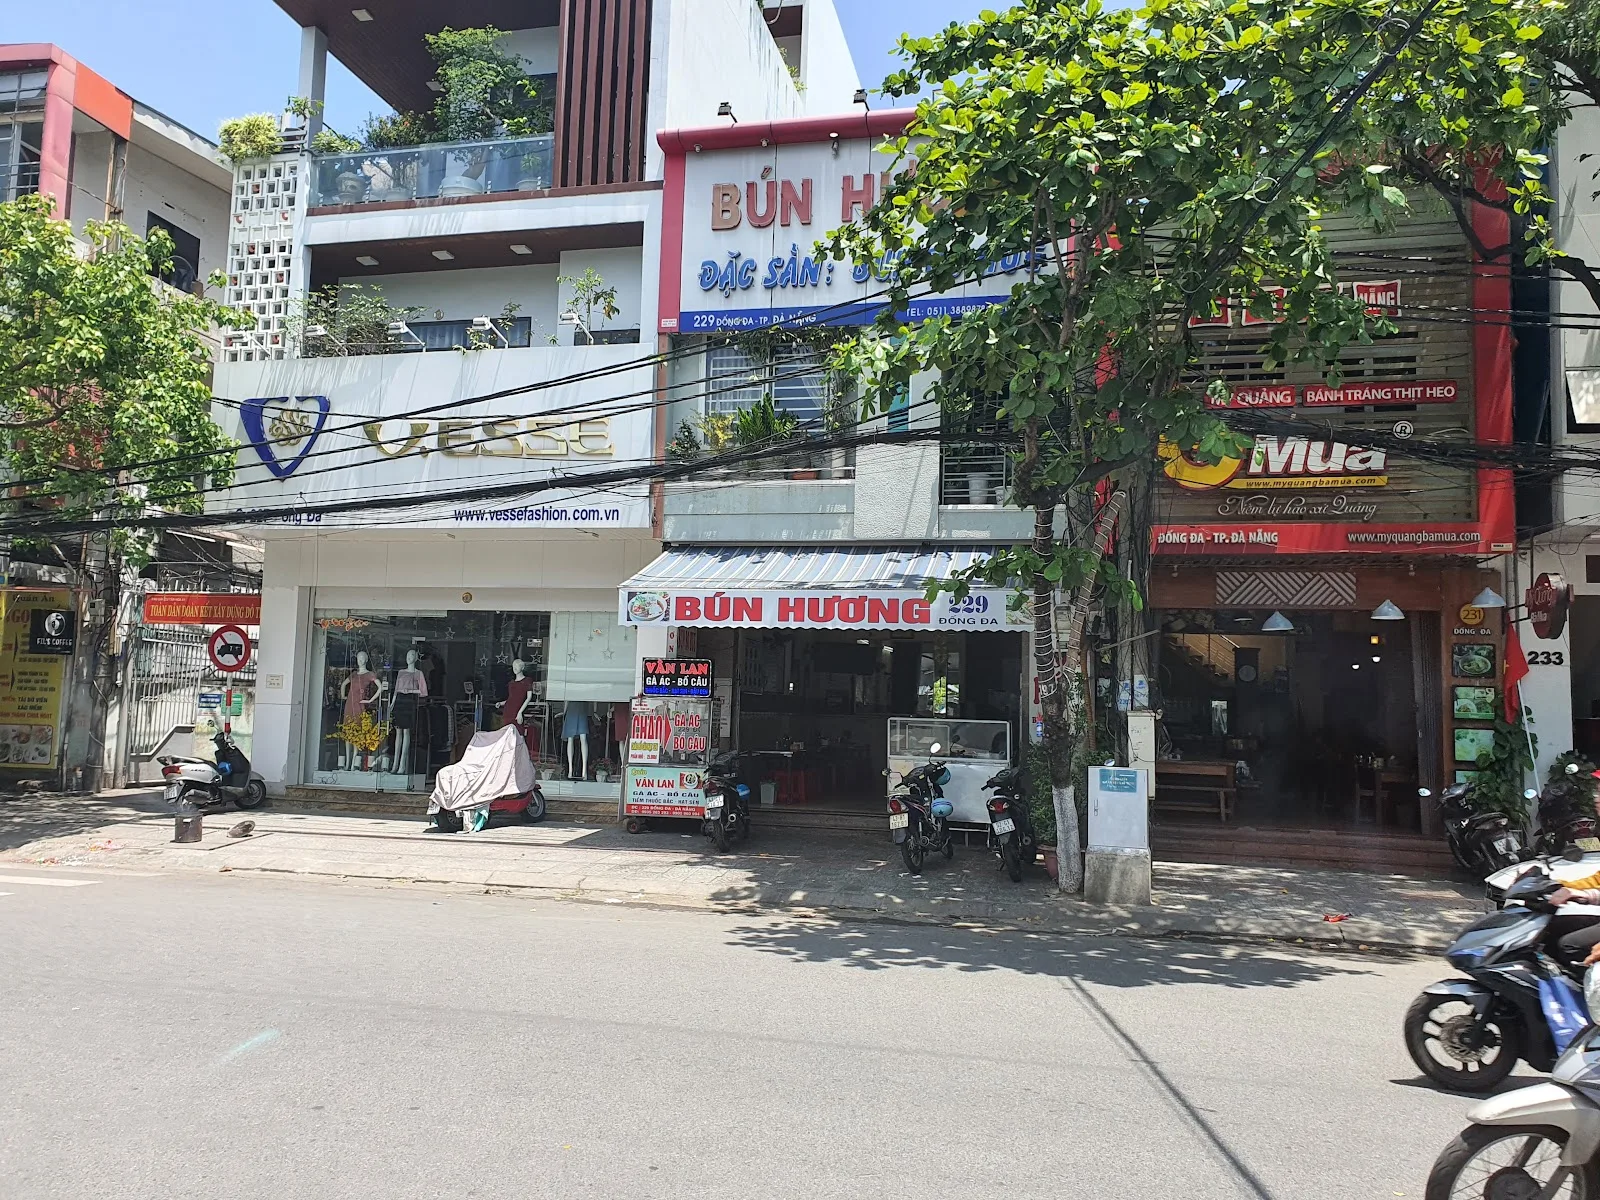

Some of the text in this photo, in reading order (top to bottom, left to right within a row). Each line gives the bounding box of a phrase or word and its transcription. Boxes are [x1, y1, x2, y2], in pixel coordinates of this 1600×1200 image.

[711, 165, 813, 230] BÚN
[699, 250, 755, 297] ĐẶC
[693, 314, 715, 328] 229
[1236, 389, 1292, 406] QUẢNG
[1305, 385, 1456, 403] BÁNH TRÁNG THỊT HEO
[1246, 476, 1377, 489] www.myquangbamua.com
[454, 506, 620, 521] www.vessefashion.com.vn
[1158, 529, 1278, 543] ĐỐNG ĐA TP. ĐÀ NẴNG
[1347, 531, 1481, 544] www.myquangbamua.com
[150, 602, 166, 617] TOÀN
[181, 602, 199, 617] ĐOÀN
[200, 601, 213, 618] KẾT
[212, 604, 226, 618] XÂY
[674, 592, 931, 624] BÚN HƯƠNG
[948, 596, 989, 613] 229
[938, 616, 998, 625] ĐỐNG ĐA
[1463, 609, 1482, 620] 231
[52, 638, 73, 646] COFFEE
[1527, 651, 1564, 665] 233
[680, 663, 709, 675] LAN
[645, 675, 657, 686] GÀ
[659, 675, 670, 686] ÁC
[691, 676, 708, 687] CÂU
[688, 712, 700, 728] ÁC
[687, 734, 706, 751] CÂU
[635, 777, 675, 788] VÂN LAN
